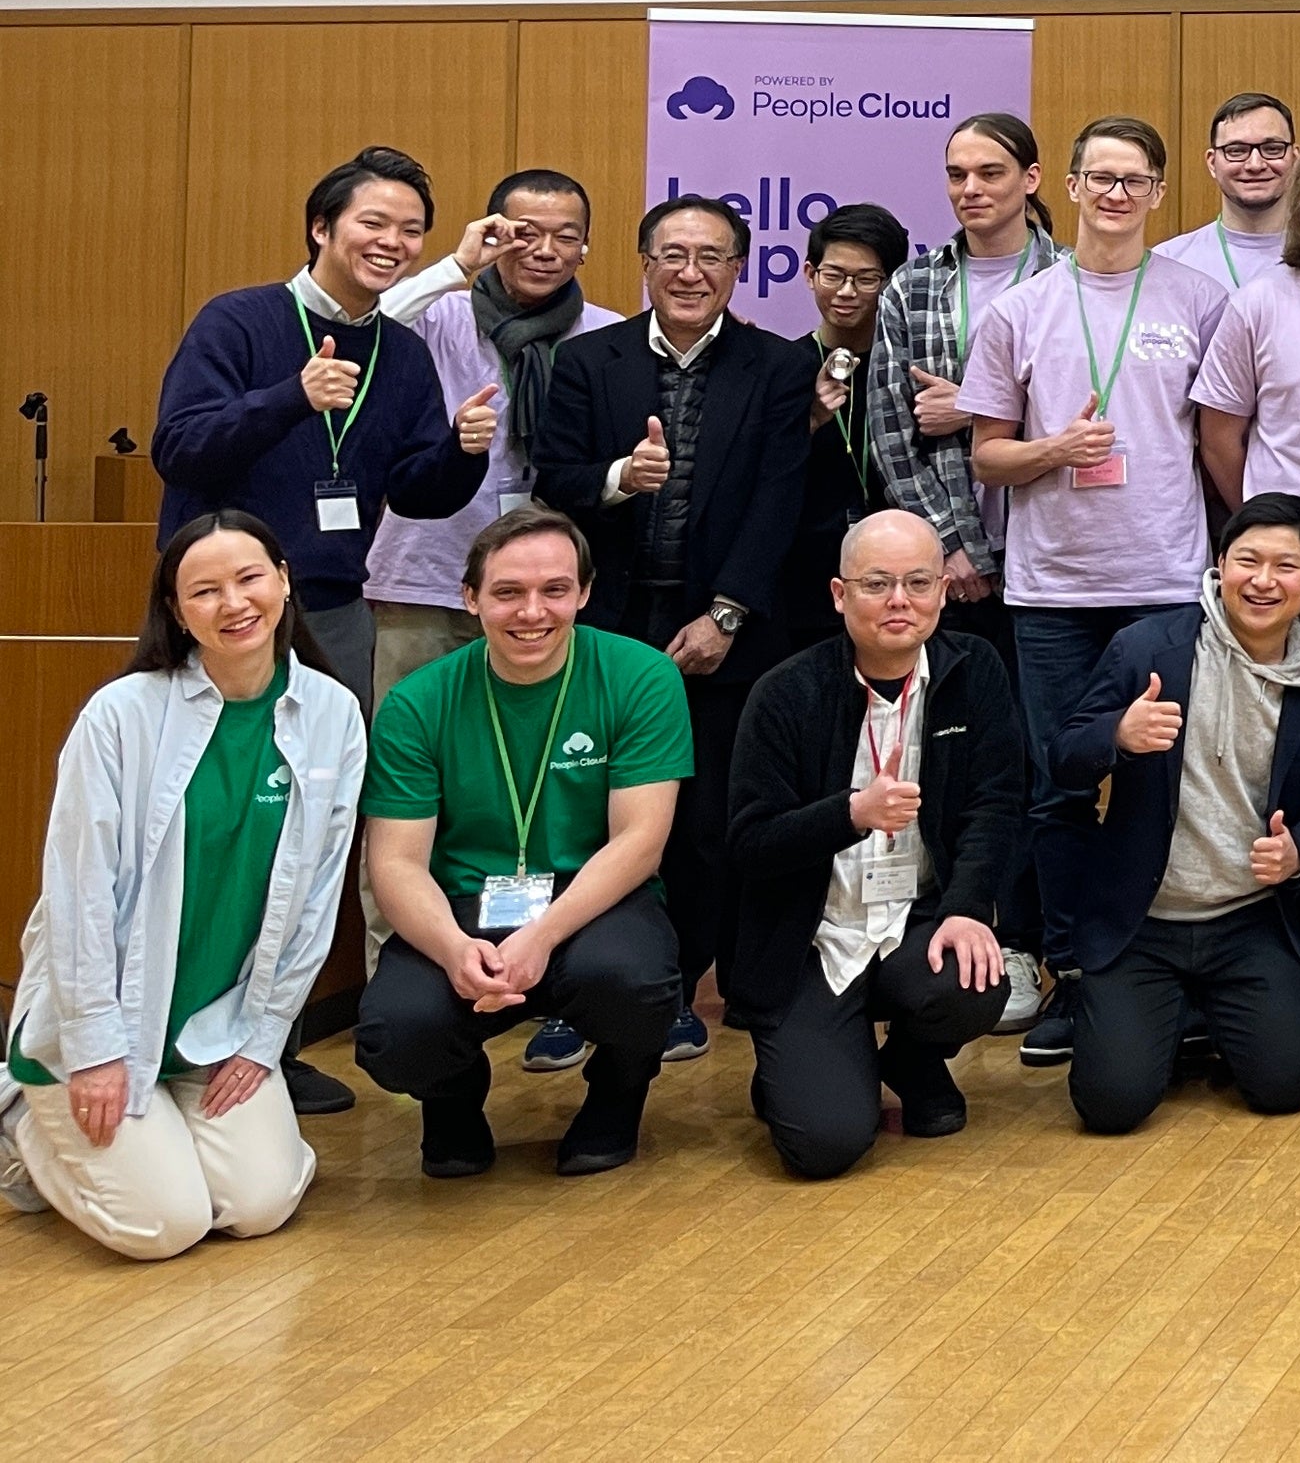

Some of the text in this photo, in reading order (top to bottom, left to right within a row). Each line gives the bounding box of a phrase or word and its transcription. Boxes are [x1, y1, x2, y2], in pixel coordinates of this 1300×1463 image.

[754, 75, 835, 86] POWERED BY
[753, 91, 951, 124] People Cloud
